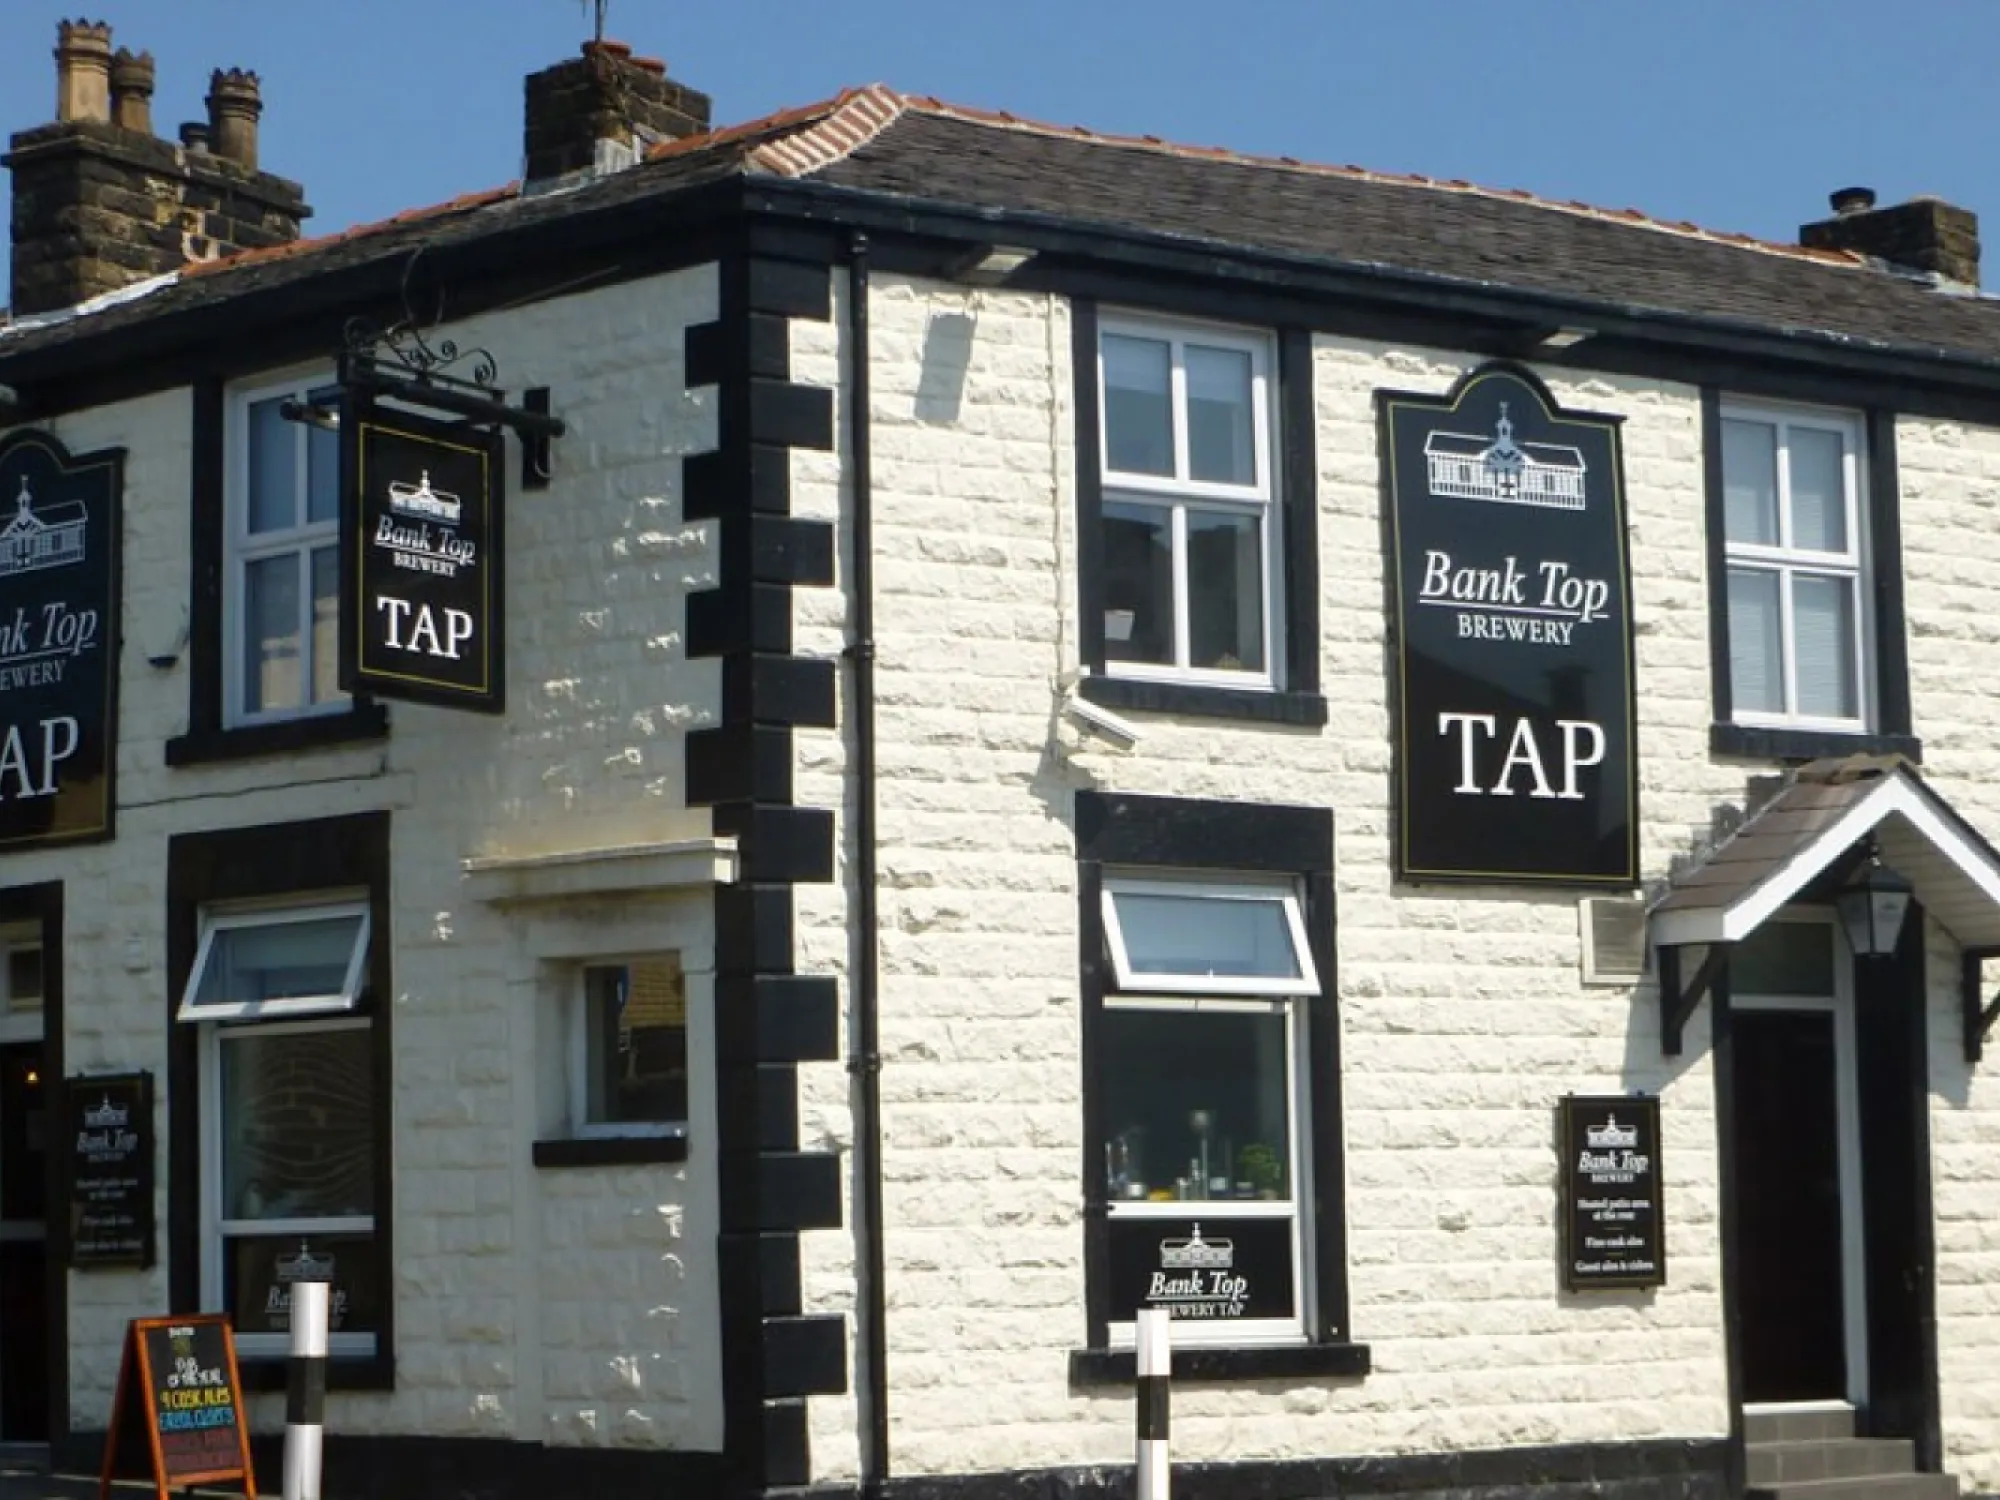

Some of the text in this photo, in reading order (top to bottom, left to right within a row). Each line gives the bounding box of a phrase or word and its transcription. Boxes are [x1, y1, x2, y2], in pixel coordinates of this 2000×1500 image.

[375, 514, 476, 566] Bank Top
[393, 552, 458, 578] BREWERY
[1420, 550, 1610, 623] Bank Top
[40, 601, 98, 656] Top
[377, 594, 474, 660] TAP
[1457, 613, 1574, 645] BREWERY
[1438, 711, 1606, 800] TAP
[1578, 1150, 1649, 1174] Bank Top
[1148, 1269, 1249, 1301] Bank Top
